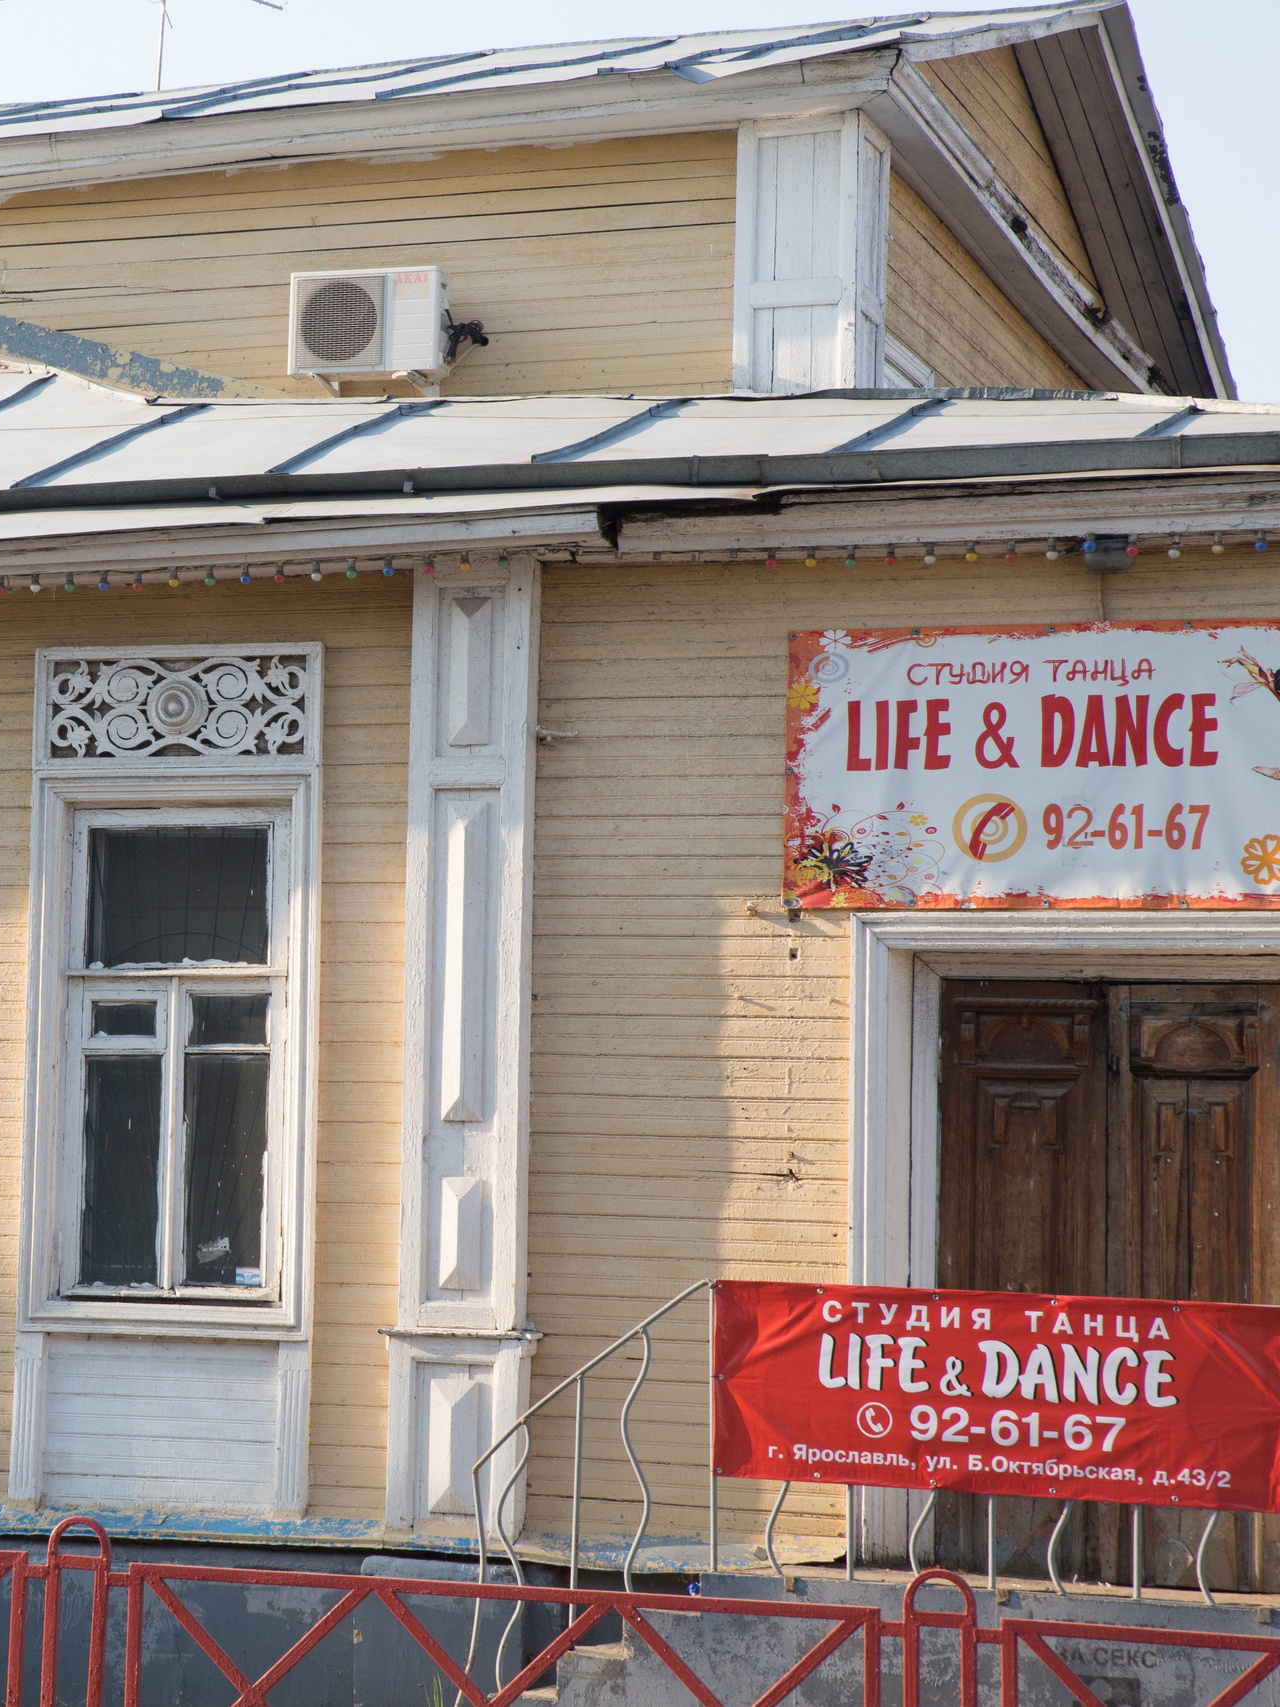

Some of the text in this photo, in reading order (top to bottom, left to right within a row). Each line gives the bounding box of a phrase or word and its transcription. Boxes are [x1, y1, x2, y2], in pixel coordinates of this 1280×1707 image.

[395, 272, 429, 284] AKAI
[907, 657, 1157, 687] СТУДИЯ ТАНЦА
[846, 692, 1219, 772] LIFE & DANCE
[1042, 803, 1211, 850] 92-61-67
[822, 1300, 1170, 1343] СТУДИЯ ТАНЦА
[818, 1333, 1179, 1408] LIFE & DANCE
[909, 1404, 1127, 1453] 92-61-67
[767, 1443, 1231, 1489] г. Ярославль, ул. Б.Октябрьская, д.43/2
